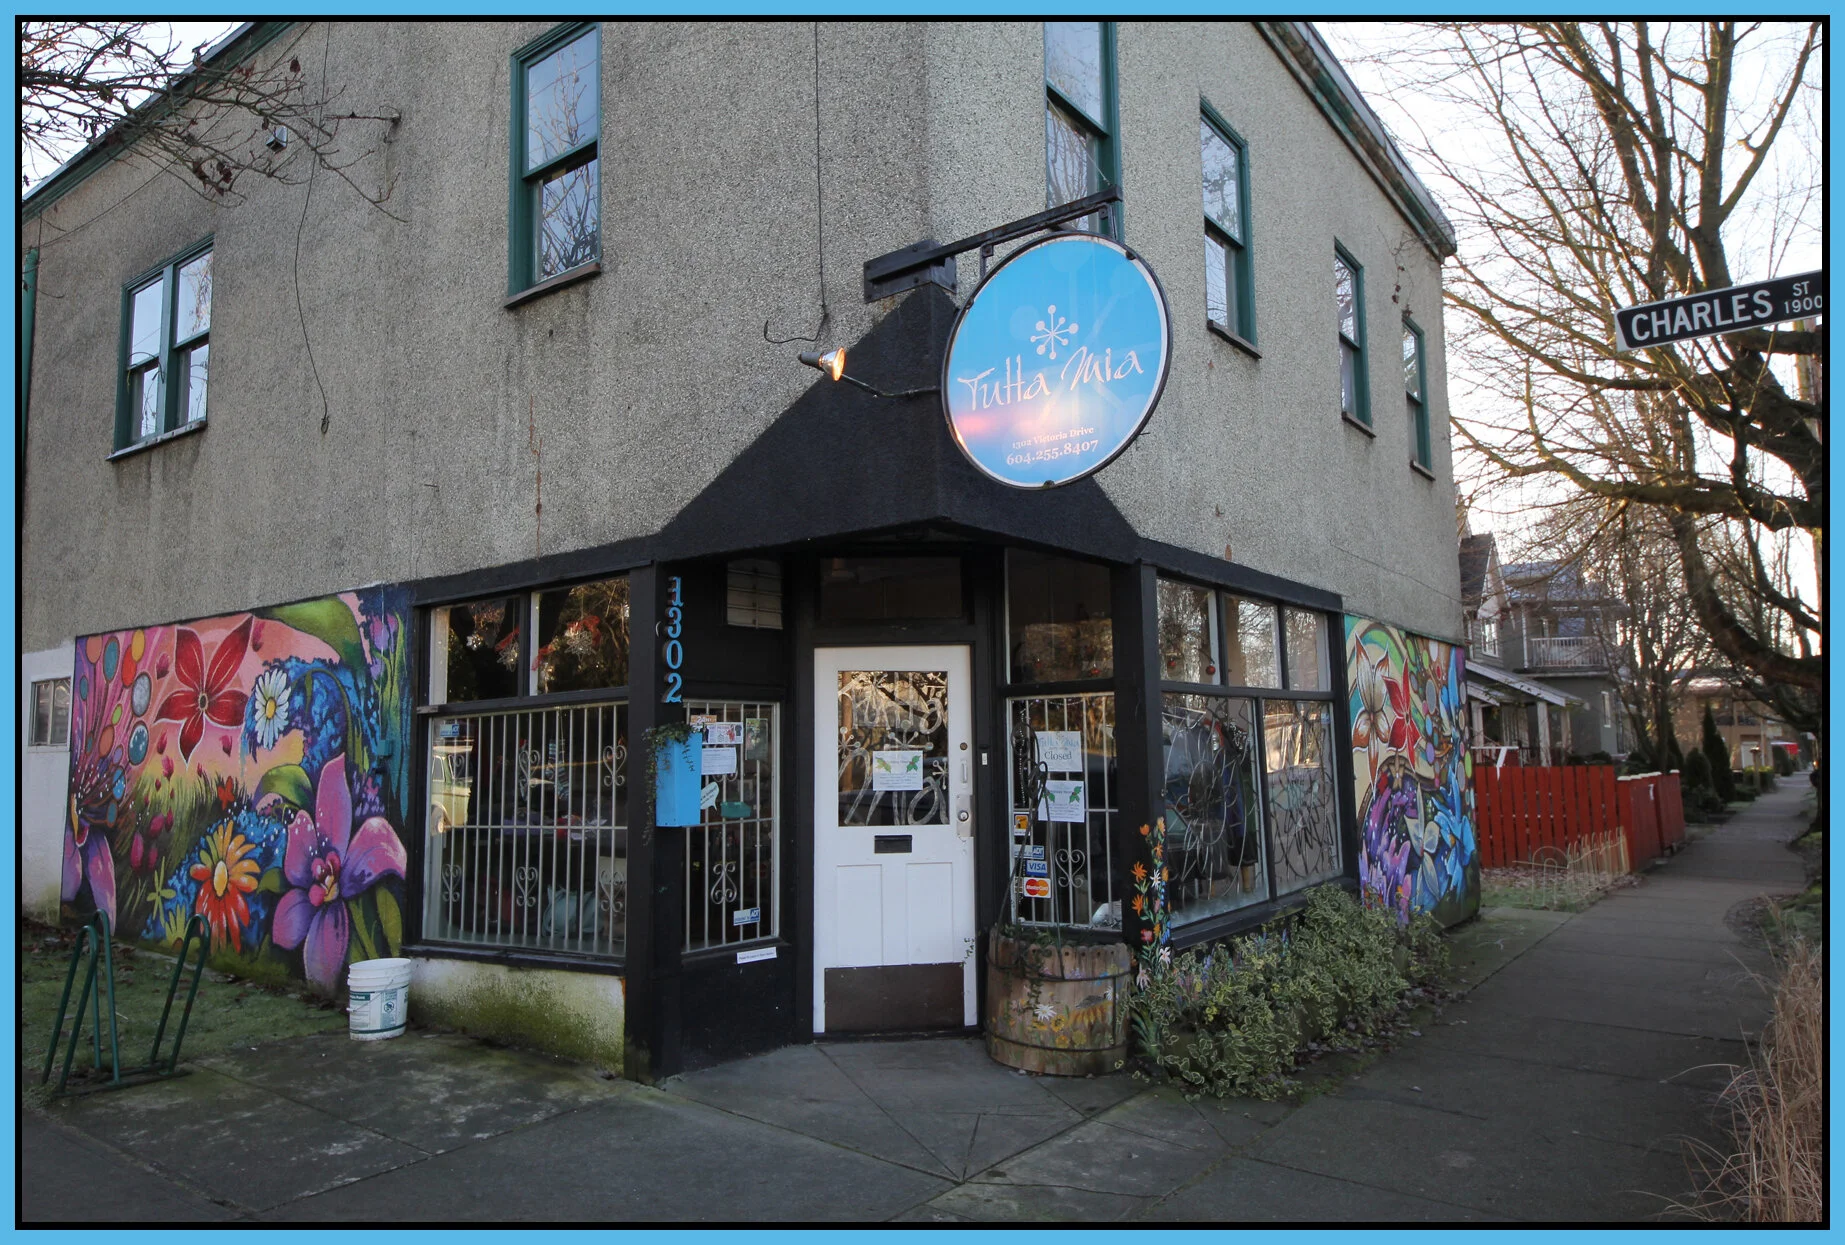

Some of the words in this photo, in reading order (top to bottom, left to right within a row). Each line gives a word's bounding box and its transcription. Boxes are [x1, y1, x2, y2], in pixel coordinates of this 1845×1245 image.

[1792, 281, 1810, 297] ST
[1631, 289, 1773, 341] CHARLES
[1784, 295, 1823, 315] 1900
[957, 354, 1052, 411] Tutta
[1060, 345, 1145, 390] Mia
[1012, 439, 1032, 450] 1302
[1033, 431, 1068, 444] Victoria
[1069, 427, 1095, 438] Drive
[1006, 439, 1099, 466] 604.255.8407
[666, 576, 684, 703] 1302
[1044, 750, 1073, 761] Closed
[1029, 862, 1047, 871] VISA
